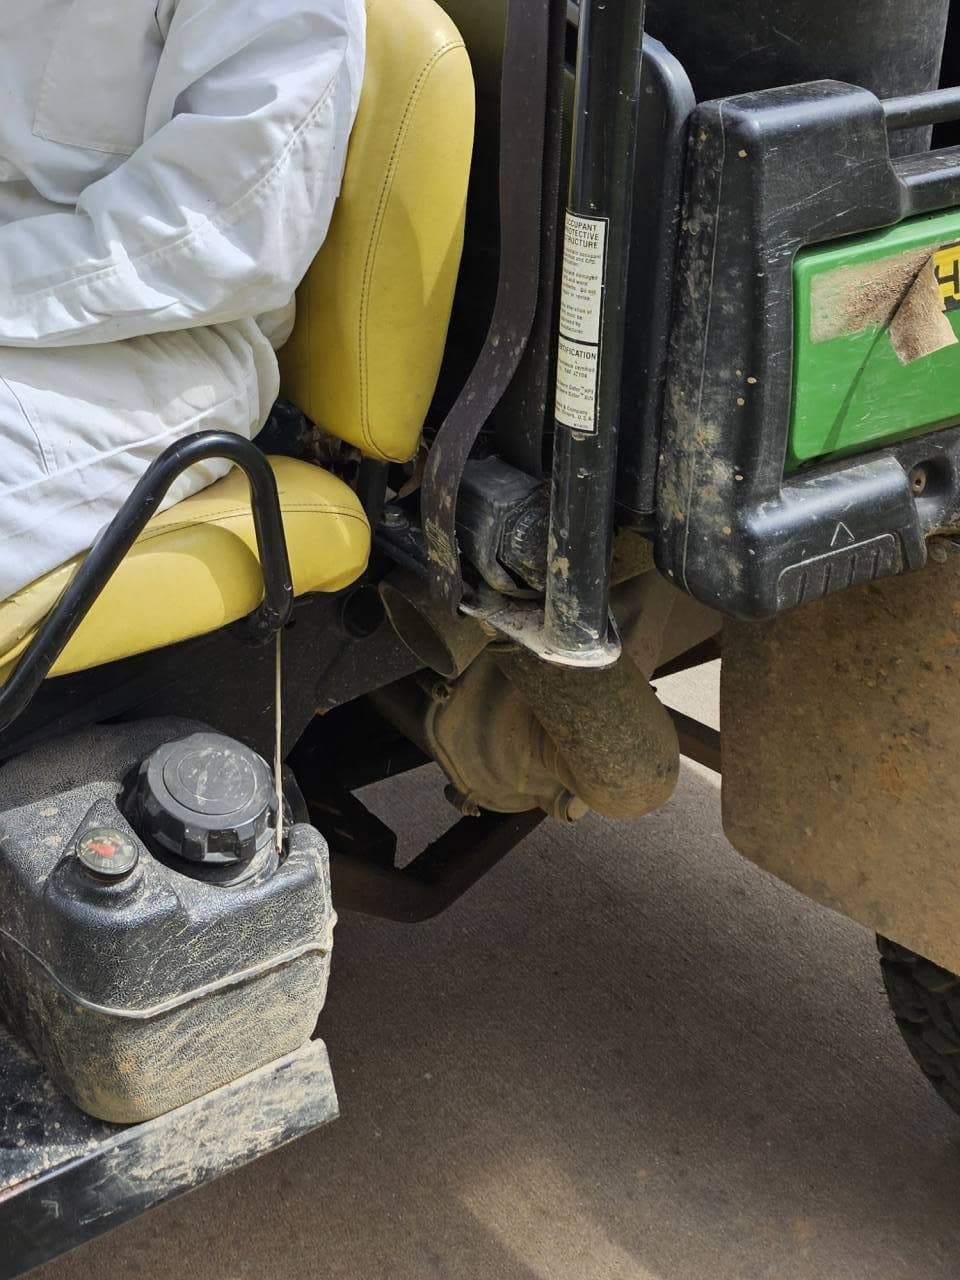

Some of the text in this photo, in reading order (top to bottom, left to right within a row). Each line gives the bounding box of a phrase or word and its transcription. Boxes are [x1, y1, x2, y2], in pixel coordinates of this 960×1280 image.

[566, 217, 597, 231] CCUPANT
[565, 225, 599, 241] ROTECTIVE
[565, 233, 598, 249] TRUCTURE
